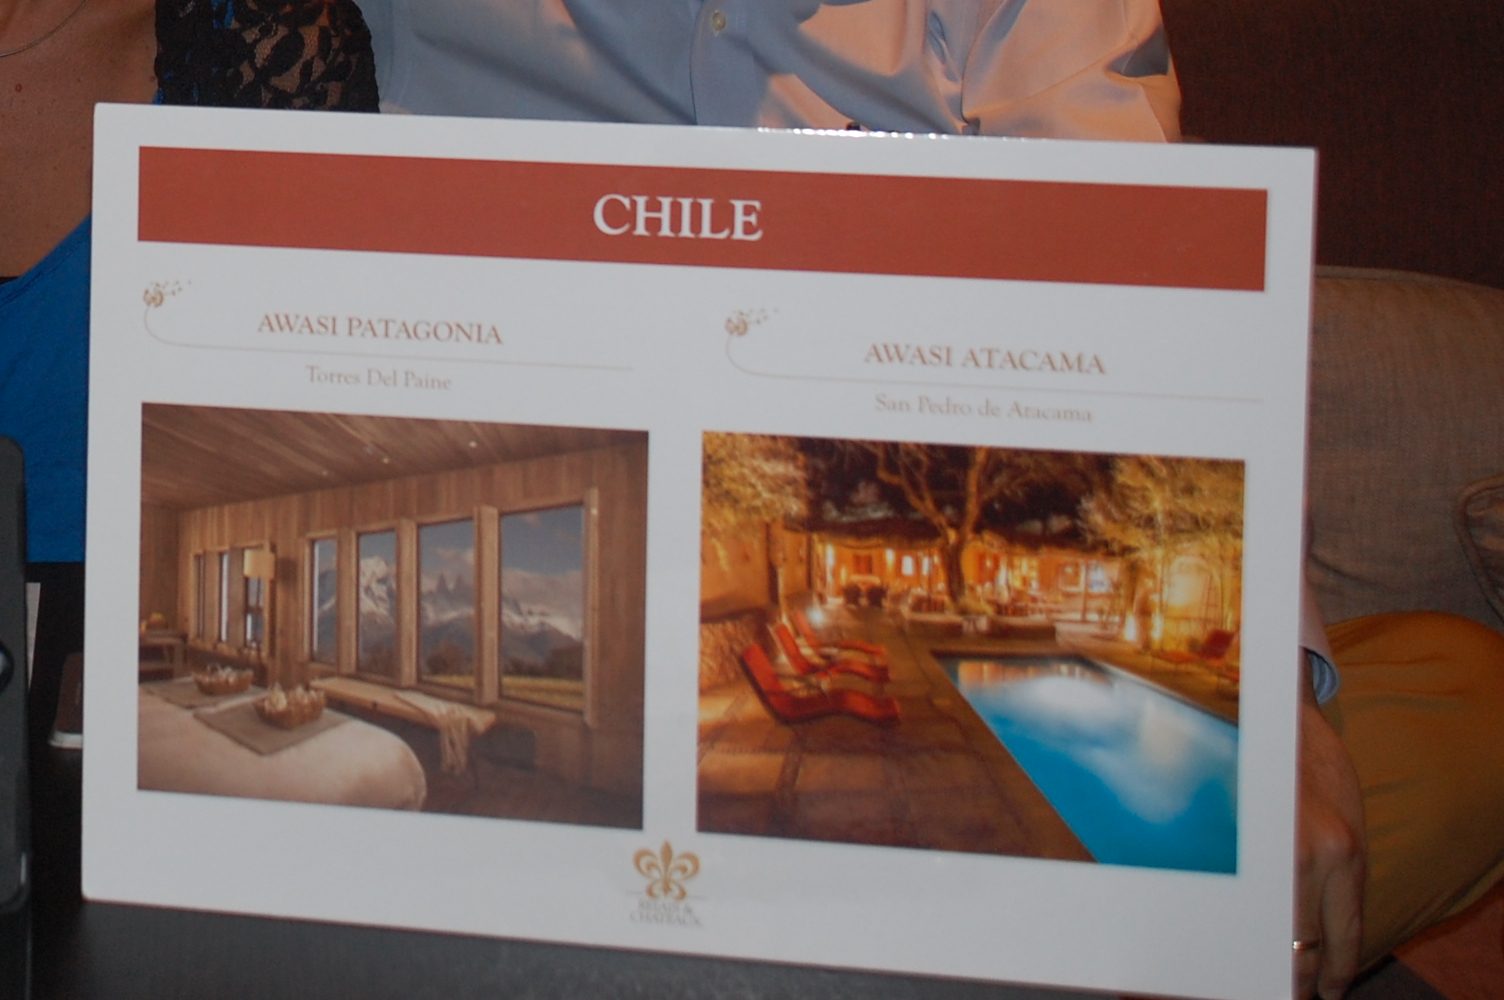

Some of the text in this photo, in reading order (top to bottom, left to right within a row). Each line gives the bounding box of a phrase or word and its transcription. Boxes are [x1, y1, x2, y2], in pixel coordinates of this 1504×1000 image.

[593, 193, 763, 241] CHILE
[257, 313, 504, 345] AWASI PATAGONIA
[864, 342, 1107, 375] AWASI ATACAMA
[305, 364, 452, 391] Torres Del Paine
[875, 393, 1093, 422] San Pedro de Atacama
